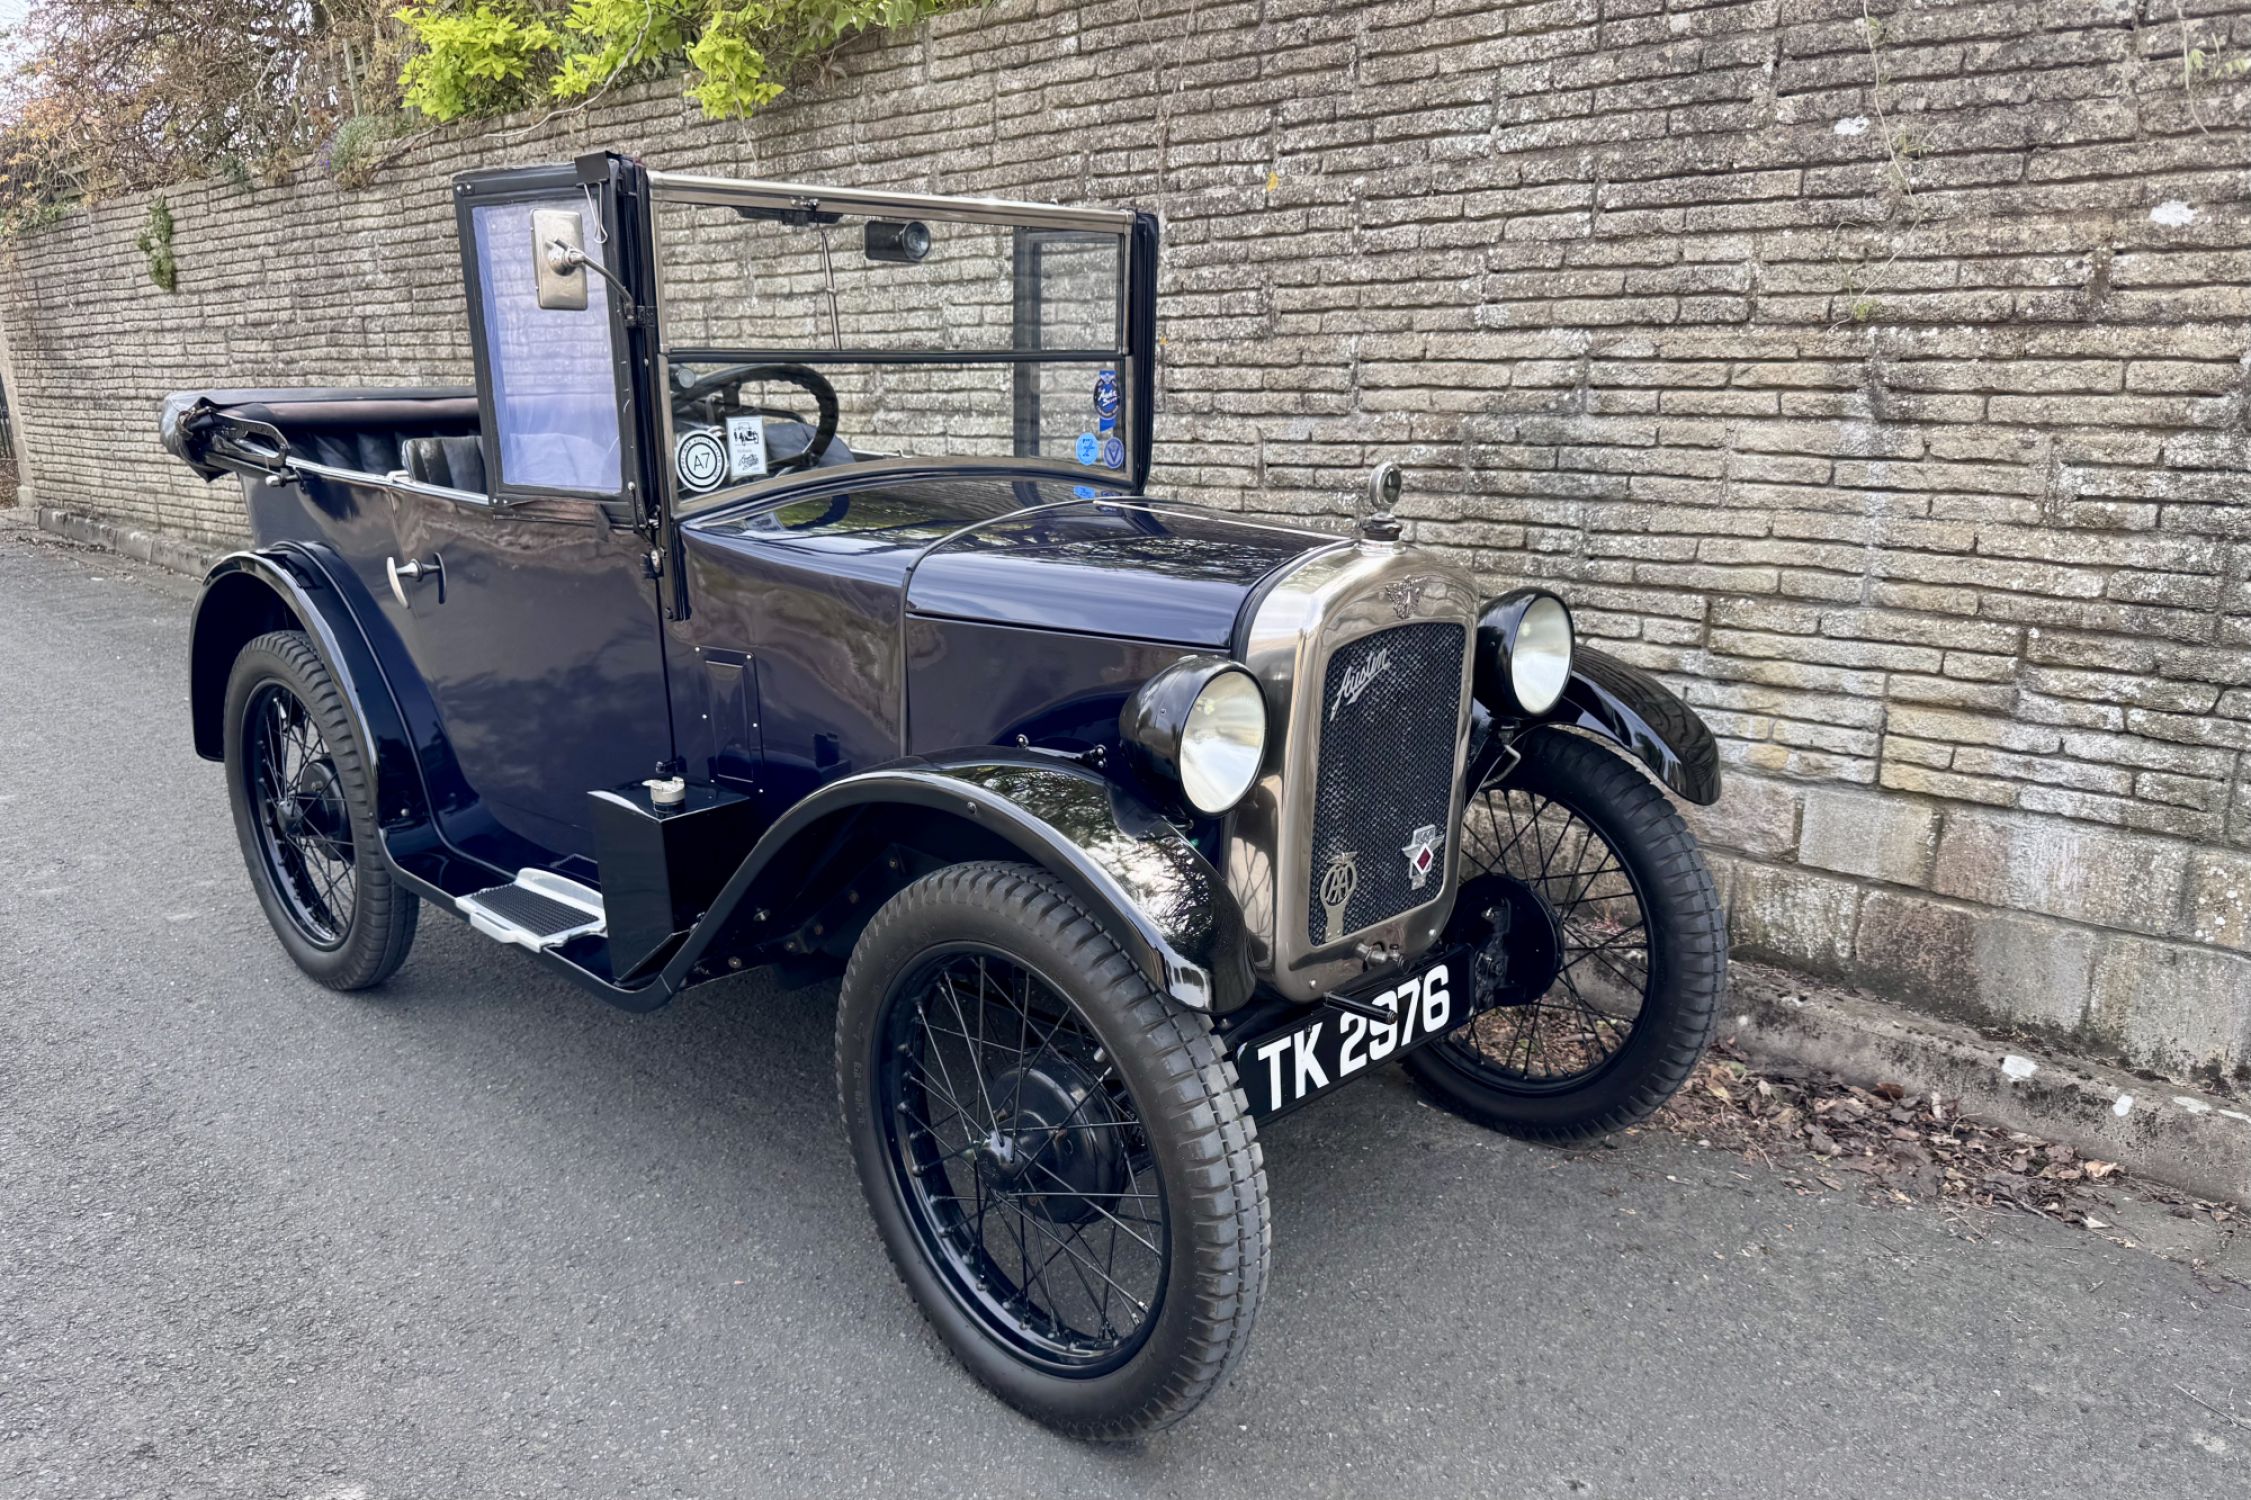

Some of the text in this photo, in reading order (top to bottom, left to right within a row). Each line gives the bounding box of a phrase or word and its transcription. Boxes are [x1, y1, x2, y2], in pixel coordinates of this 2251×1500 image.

[694, 452, 710, 471] A7
[1330, 648, 1391, 722] Austin
[1257, 963, 1451, 1112] TK 2976
